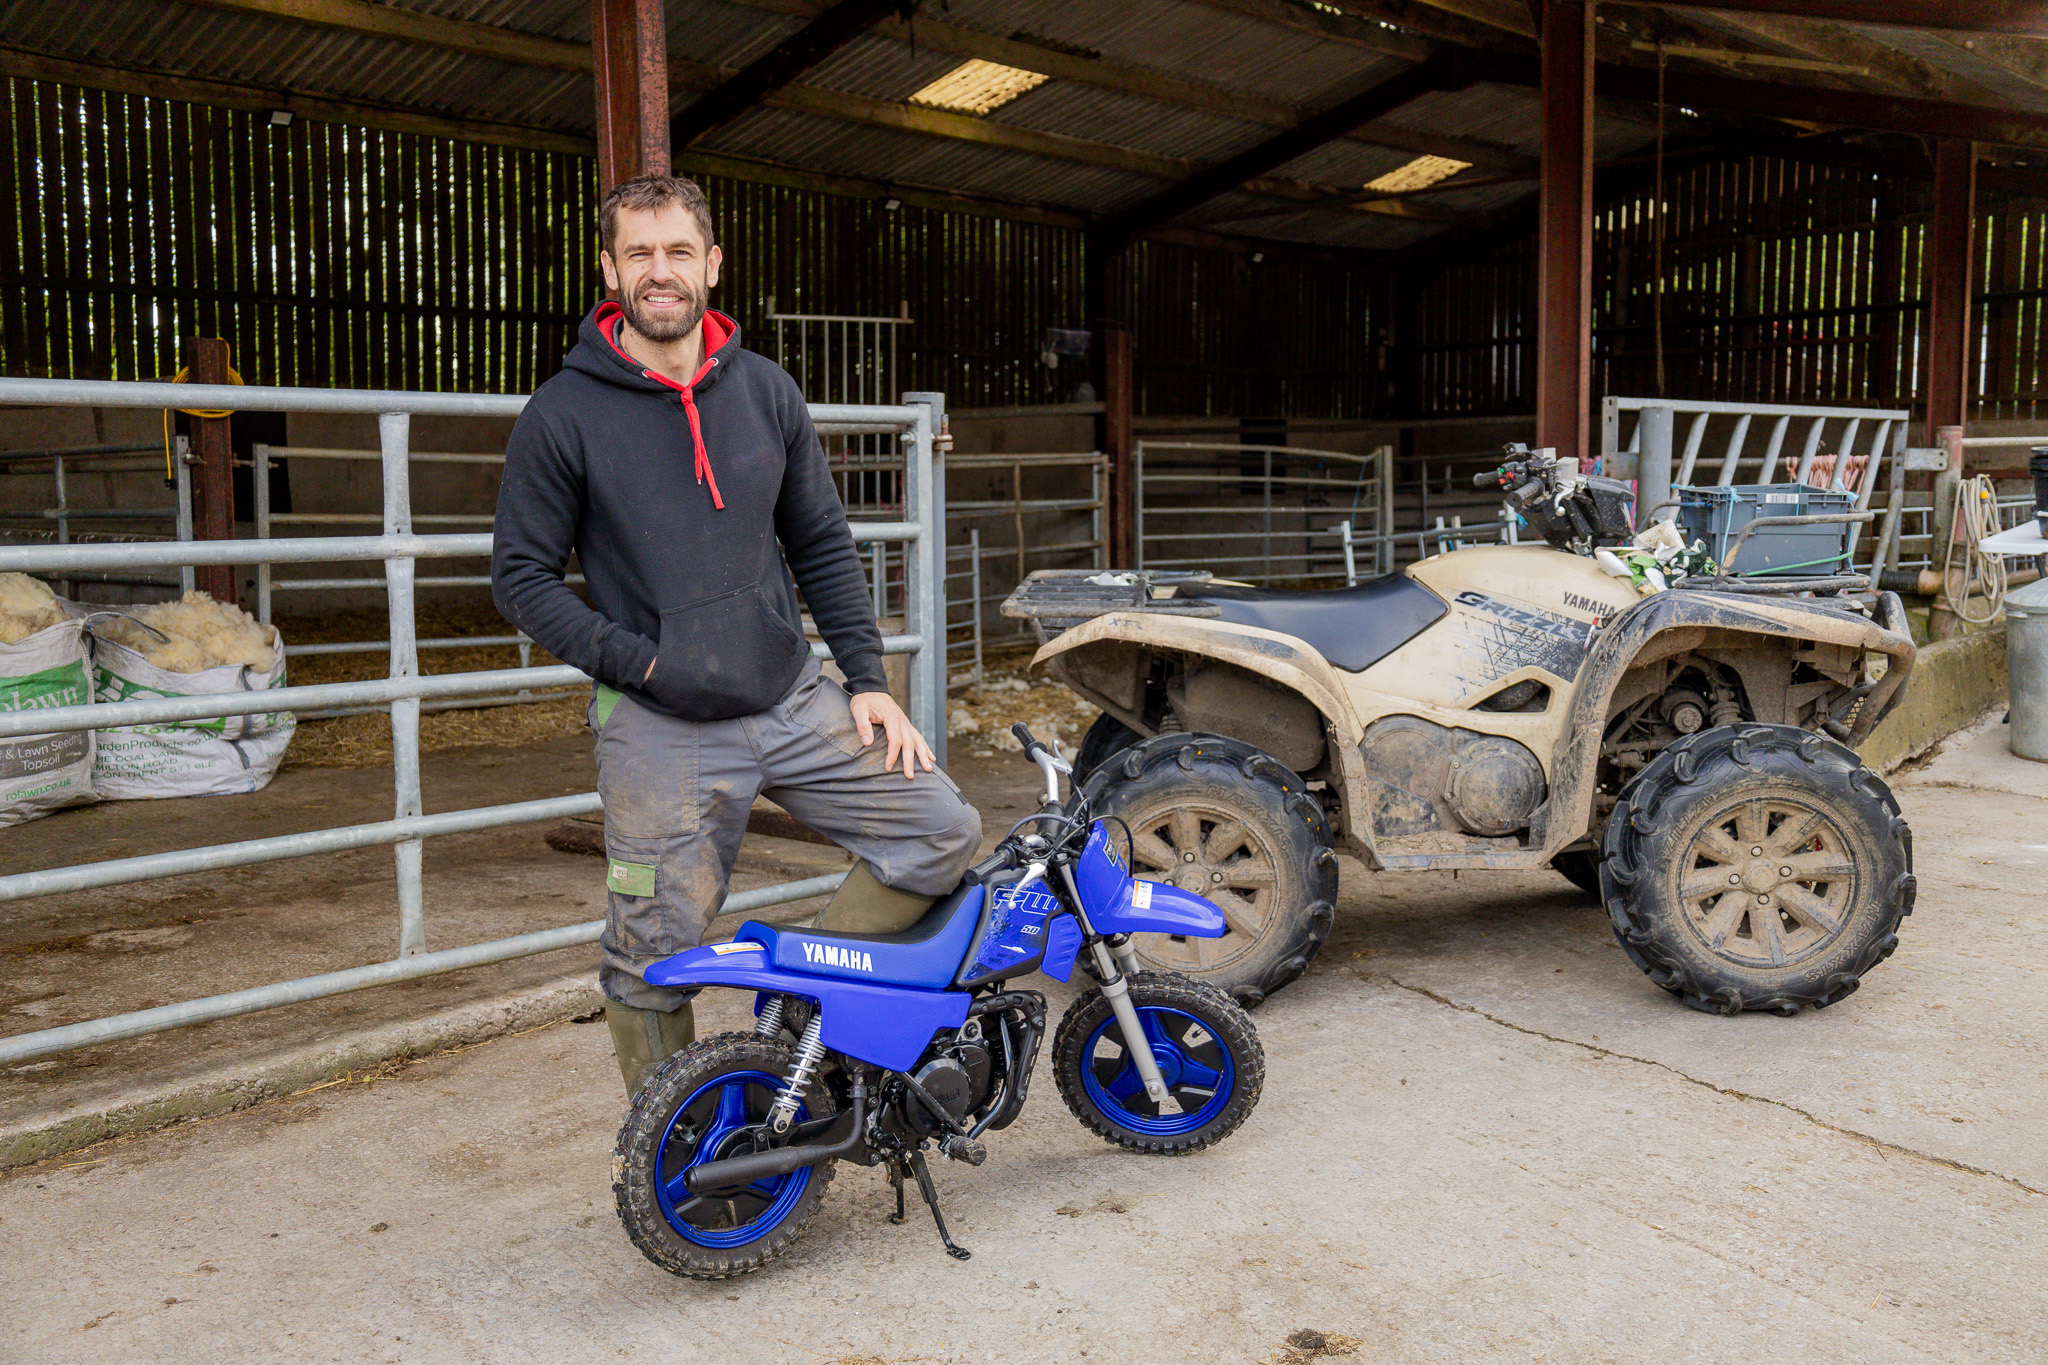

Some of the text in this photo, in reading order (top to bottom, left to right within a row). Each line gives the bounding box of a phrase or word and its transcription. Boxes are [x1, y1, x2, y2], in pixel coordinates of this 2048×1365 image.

[1563, 591, 1616, 615] YAMAHA
[5, 748, 16, 760] &
[17, 745, 49, 759] Lawn
[21, 753, 61, 772] Topsoil
[115, 754, 149, 763] COAL
[144, 758, 178, 770] ROAD
[1205, 784, 1293, 851] MAXXIS
[1804, 901, 1882, 984] MAXXIS
[802, 941, 873, 972] YAMAHA
